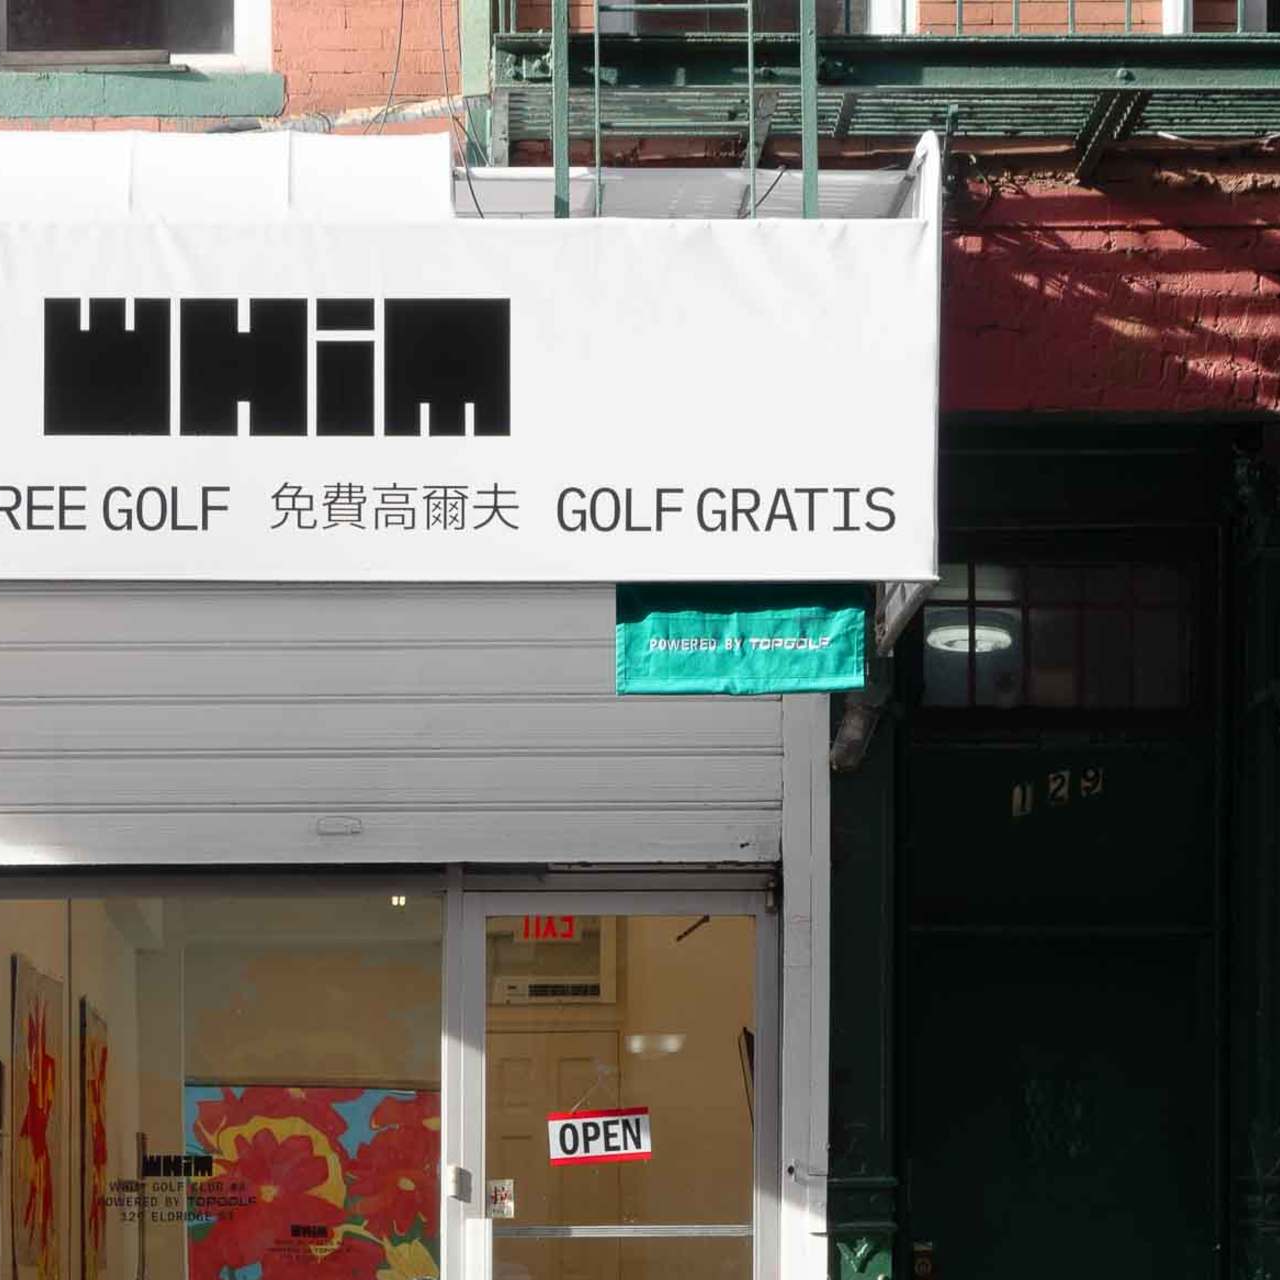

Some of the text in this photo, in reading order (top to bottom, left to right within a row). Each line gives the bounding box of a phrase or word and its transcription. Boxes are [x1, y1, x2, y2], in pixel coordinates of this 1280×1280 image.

[101, 485, 231, 532] GOLF
[270, 481, 520, 531] 免費高爾夫
[556, 487, 896, 533] GOLF GRATIS
[649, 636, 831, 652] POWERED BY TOPGOLF
[559, 1118, 642, 1155] OPEN
[152, 1181, 184, 1193] GOLF
